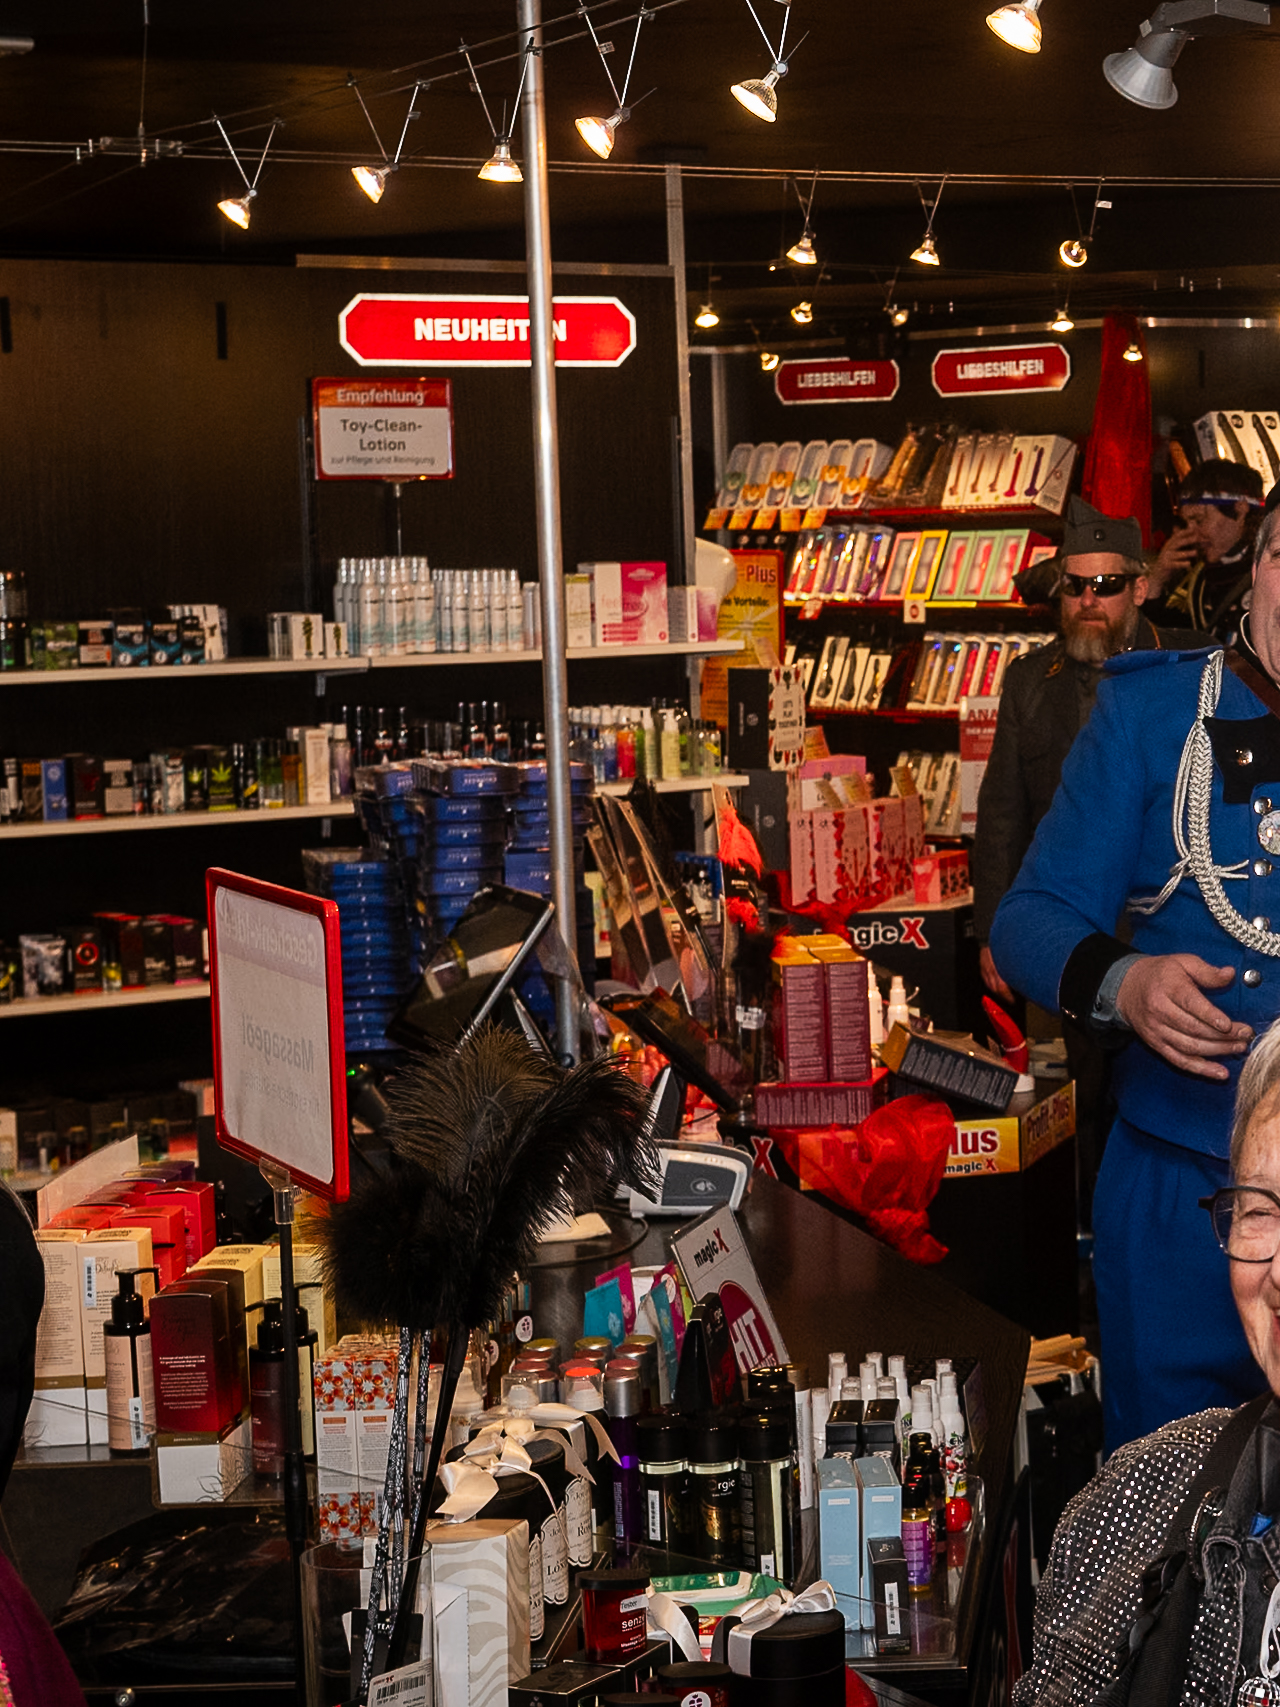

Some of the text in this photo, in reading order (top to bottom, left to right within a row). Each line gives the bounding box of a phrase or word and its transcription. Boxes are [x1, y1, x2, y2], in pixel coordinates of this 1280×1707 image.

[414, 317, 567, 342] NEUHEITN
[957, 359, 1045, 380] LIEBESHILFEN
[797, 370, 877, 388] LIEBESHILFEN
[337, 388, 424, 406] Empfehlung
[340, 419, 423, 433] Toy-Clean-
[360, 439, 406, 451] Lotion
[621, 1600, 638, 1610] Tester
